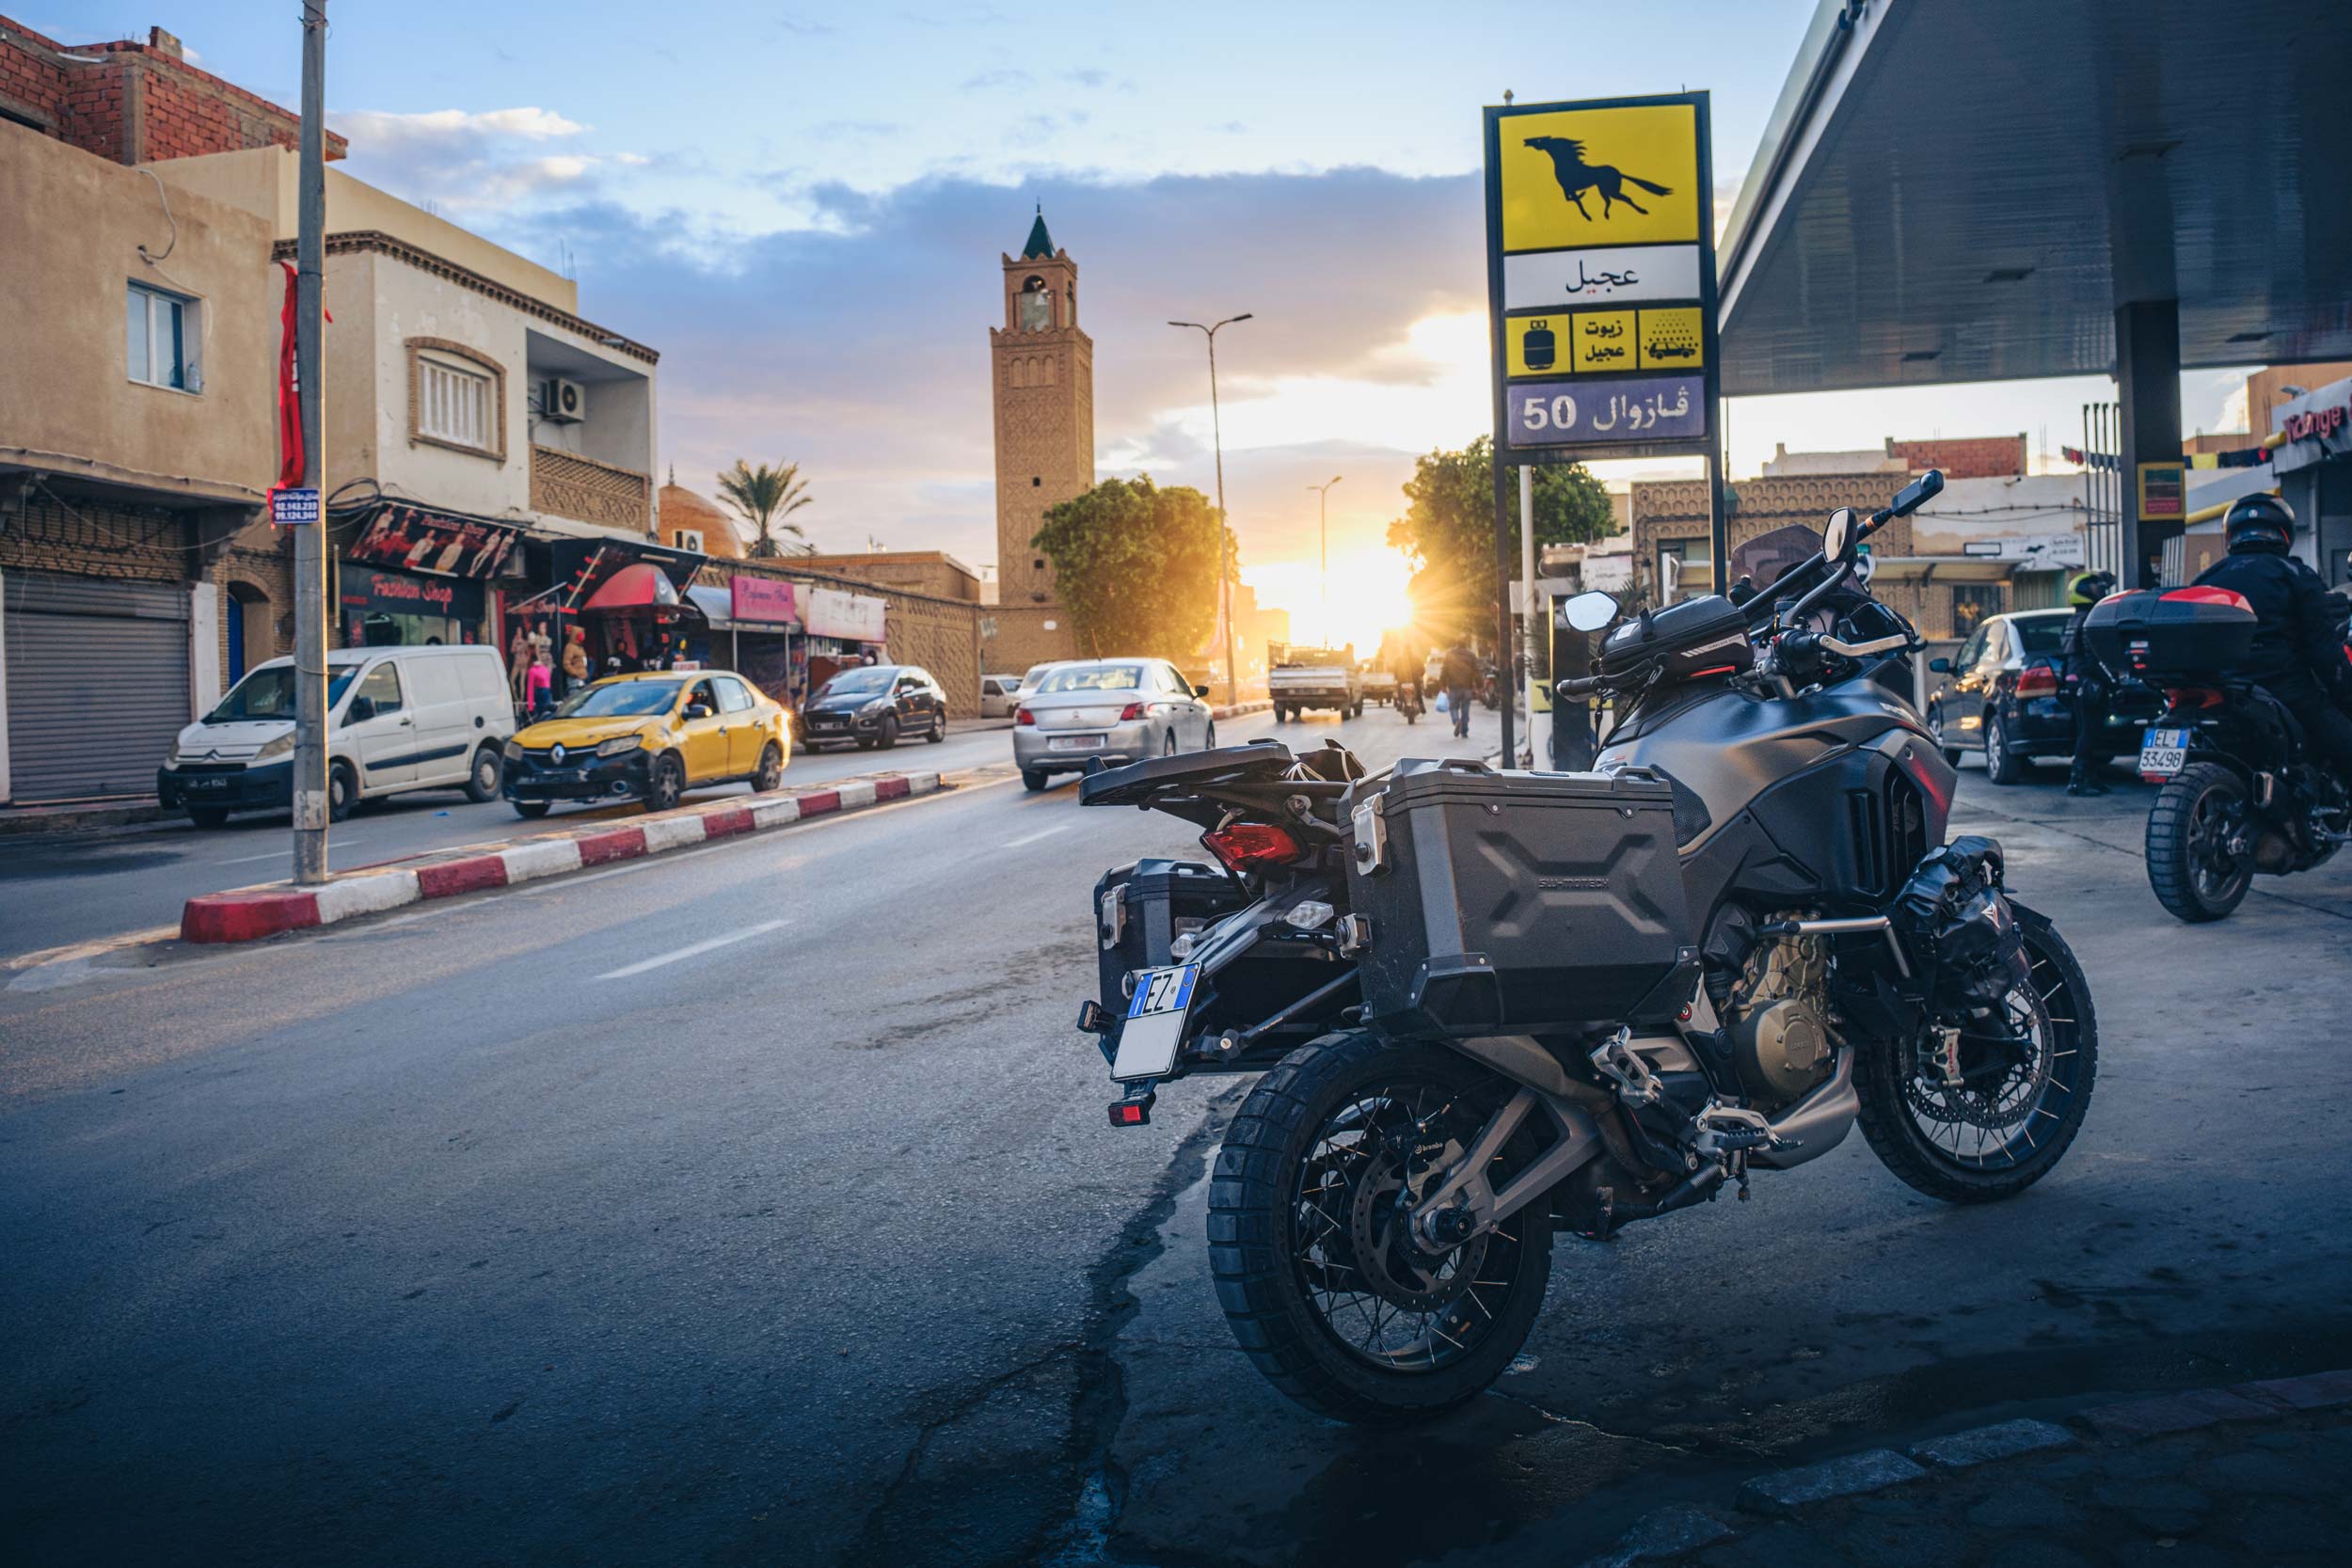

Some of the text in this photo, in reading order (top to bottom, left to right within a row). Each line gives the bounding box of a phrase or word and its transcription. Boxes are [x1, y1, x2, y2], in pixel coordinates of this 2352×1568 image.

[1565, 259, 1639, 293] عجيل
[1584, 320, 1624, 338] زيوت
[1584, 344, 1625, 362] عجيل
[1523, 395, 1577, 430] 50
[371, 574, 420, 599] Fashion
[2154, 730, 2169, 747] EL
[2141, 752, 2182, 768] 33498
[1539, 879, 1610, 888] SW-MOTECH
[1143, 973, 1174, 1014] EZ
